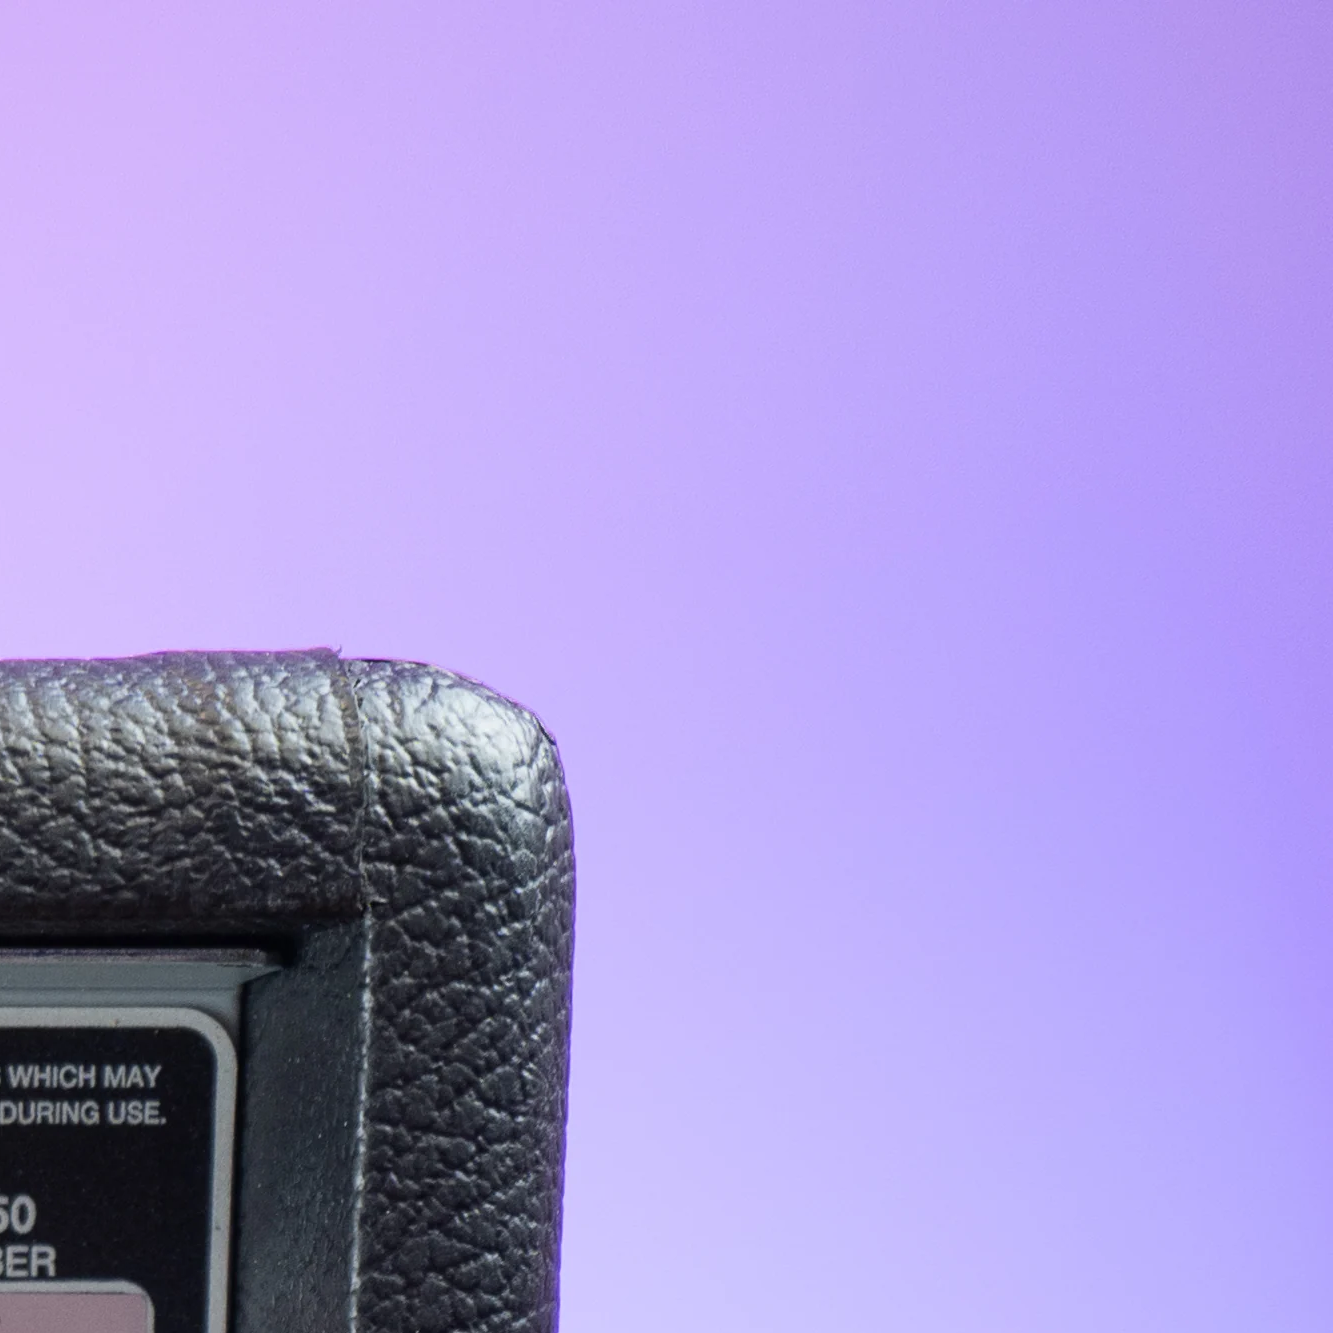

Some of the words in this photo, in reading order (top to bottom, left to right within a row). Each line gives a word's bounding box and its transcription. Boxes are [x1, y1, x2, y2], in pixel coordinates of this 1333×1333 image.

[8, 1063, 97, 1089] WHICH
[103, 1064, 162, 1089] MAY
[106, 1099, 167, 1126] USE.
